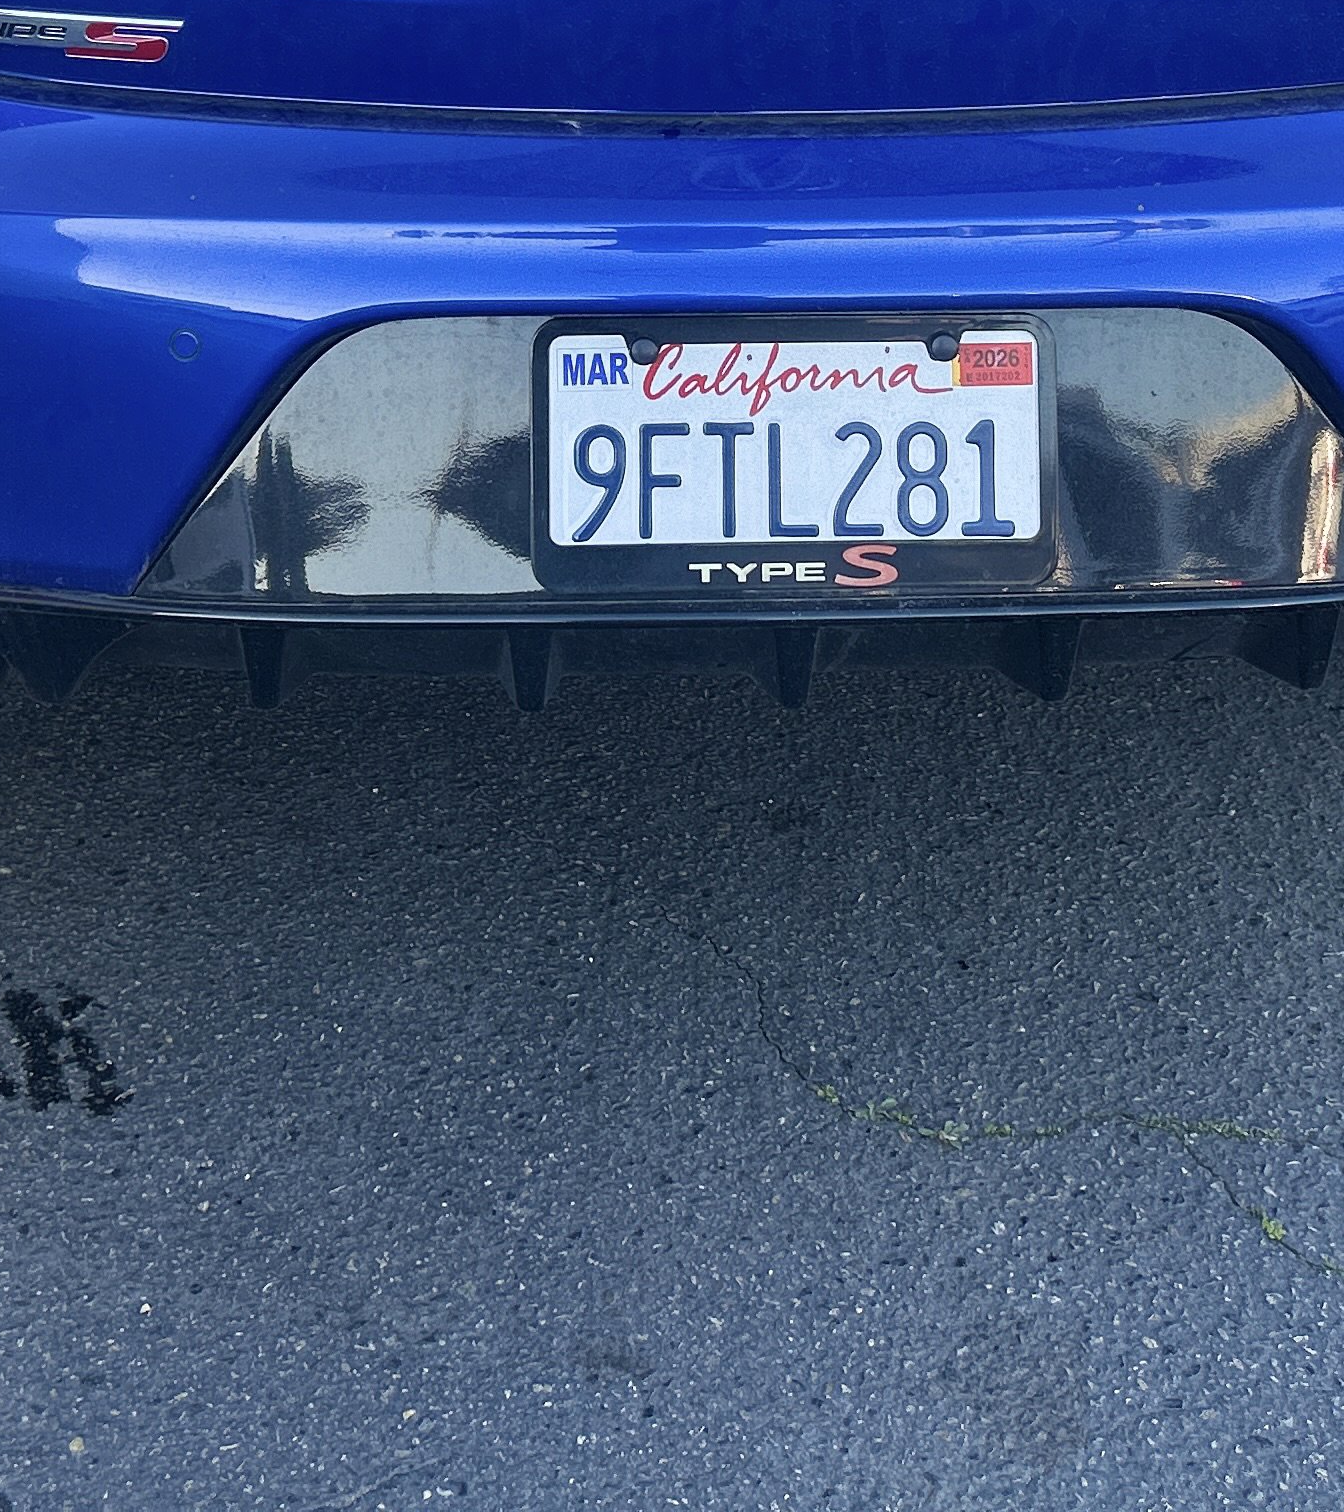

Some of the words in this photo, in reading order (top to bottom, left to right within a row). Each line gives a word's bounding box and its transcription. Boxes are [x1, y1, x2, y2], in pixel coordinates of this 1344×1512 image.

[64, 18, 185, 63] S
[562, 352, 630, 387] MAR
[642, 342, 954, 417] California
[972, 348, 1020, 368] 2026
[571, 419, 1016, 543] 9FTL281
[688, 561, 826, 584] TYPE
[834, 543, 900, 587] S
